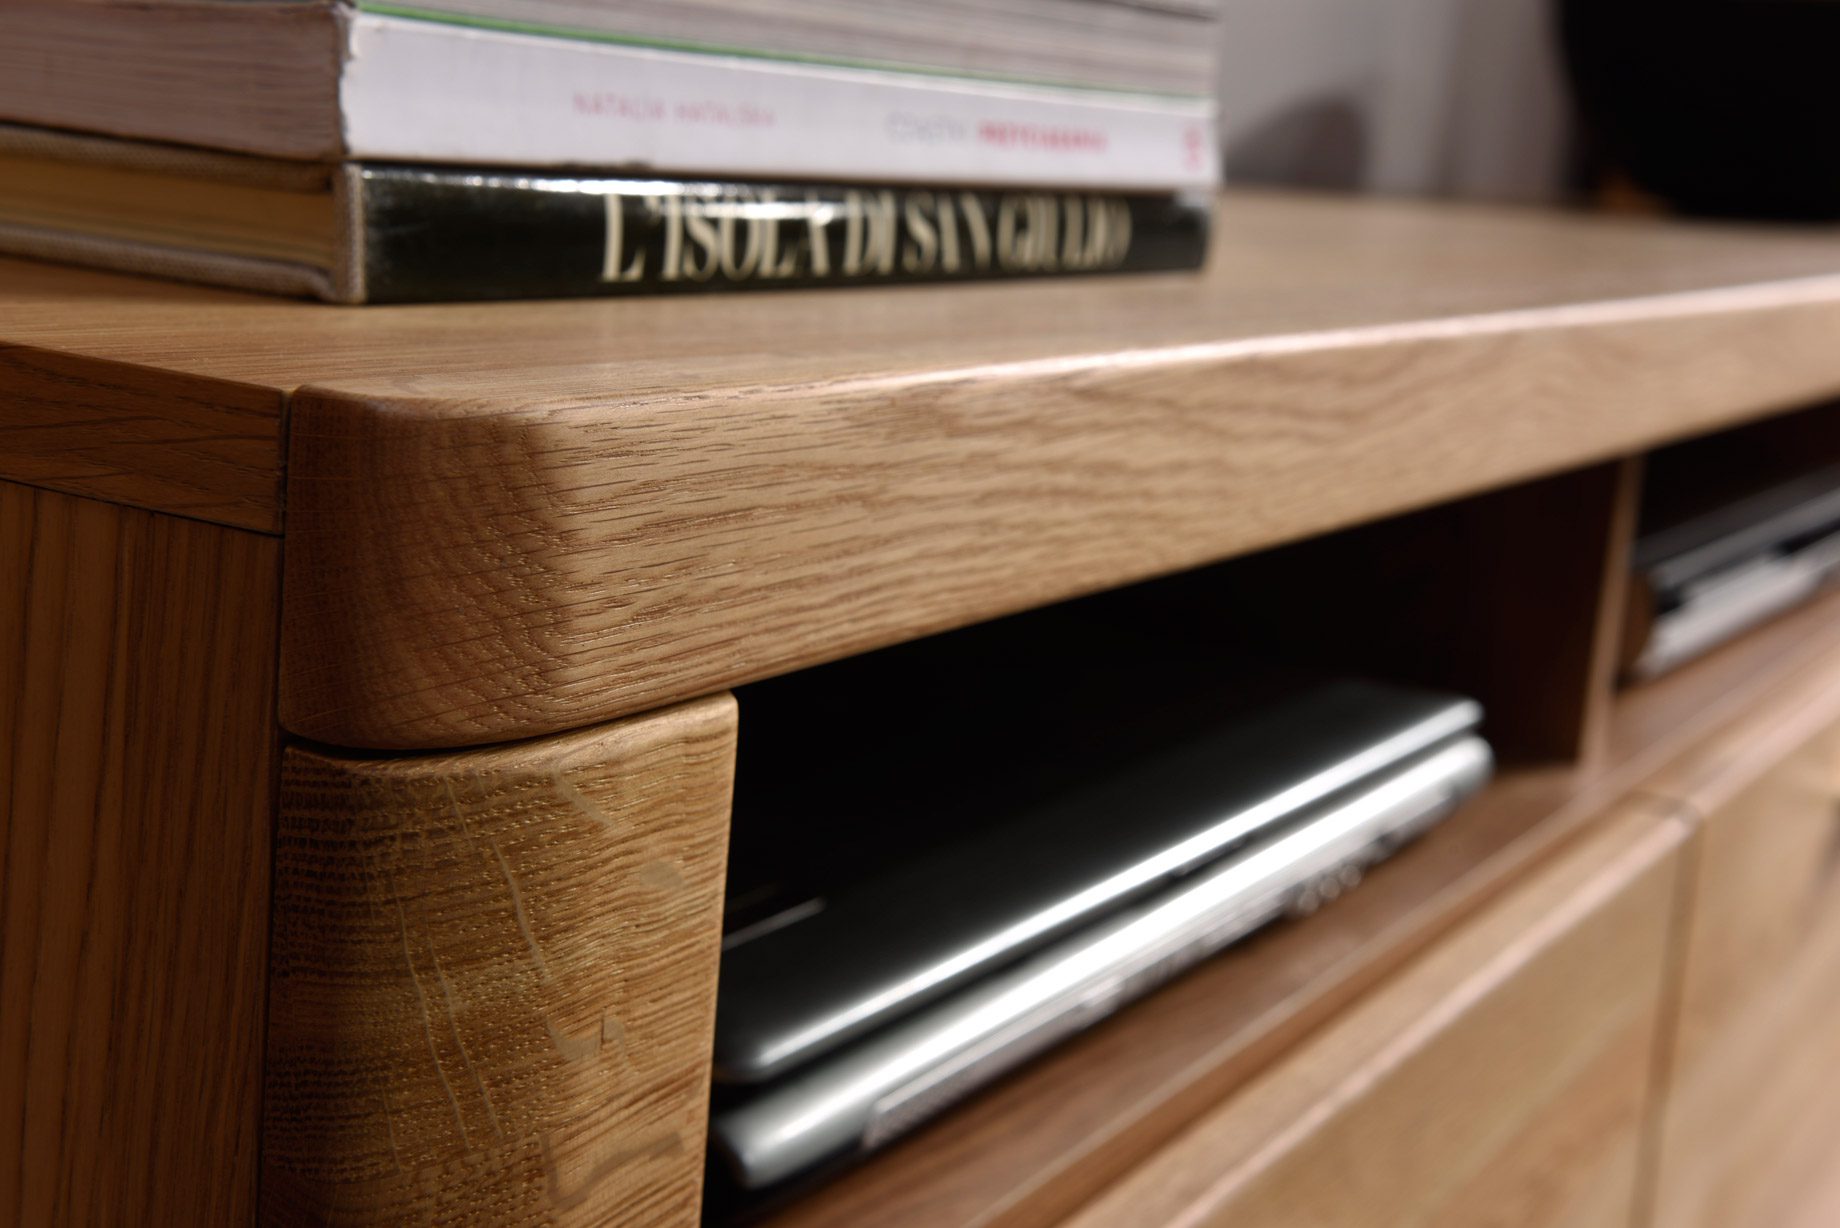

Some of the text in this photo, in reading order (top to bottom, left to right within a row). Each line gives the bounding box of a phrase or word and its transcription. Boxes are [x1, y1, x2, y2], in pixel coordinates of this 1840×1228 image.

[600, 188, 830, 282] L'ISOLA
[843, 189, 898, 276] DI
[902, 190, 991, 274] SAN
